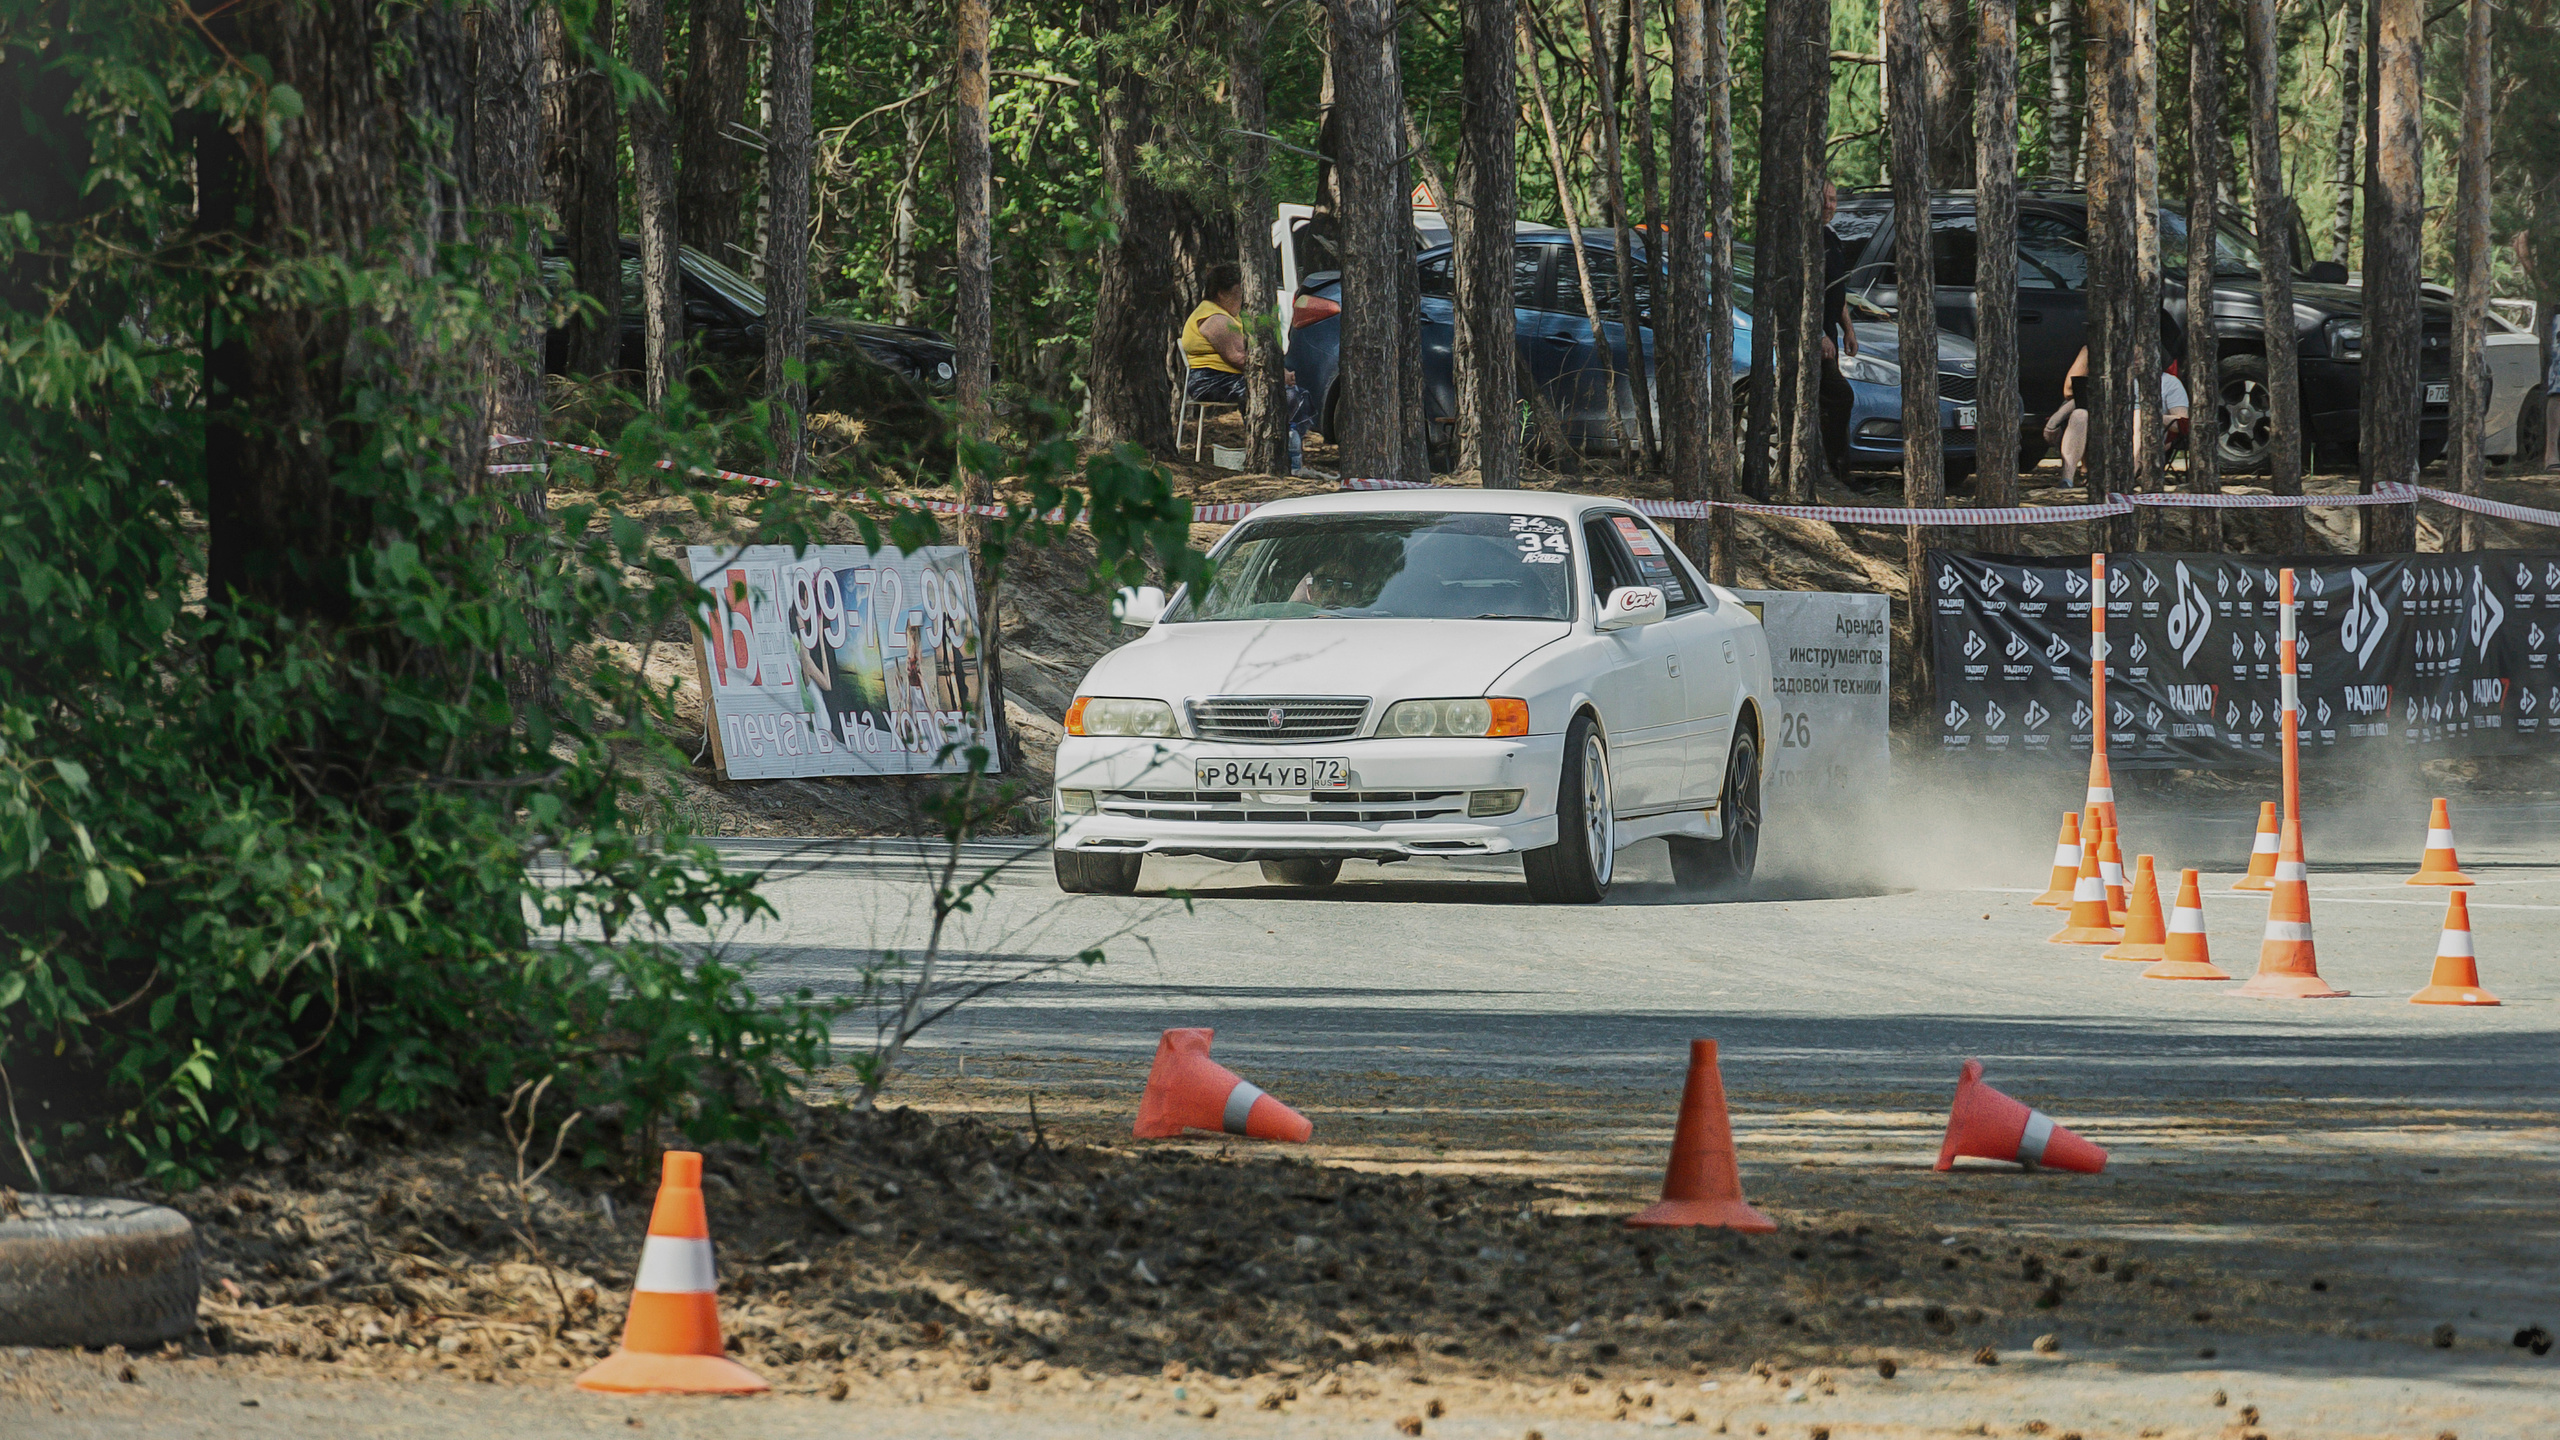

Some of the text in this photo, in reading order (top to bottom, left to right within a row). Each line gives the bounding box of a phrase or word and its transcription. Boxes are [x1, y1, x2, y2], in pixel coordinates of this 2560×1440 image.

[1515, 533, 1570, 554] 34
[792, 566, 967, 650] 99-72-99
[1835, 613, 1884, 638] Аренда
[1789, 647, 1883, 668] инструментов
[1773, 673, 1882, 696] садовой техники
[726, 712, 834, 757] печать
[838, 710, 882, 753] на
[1779, 712, 1811, 749] 26
[1207, 760, 1340, 786] Р844УВ 72
[1314, 779, 1333, 787] RUS
